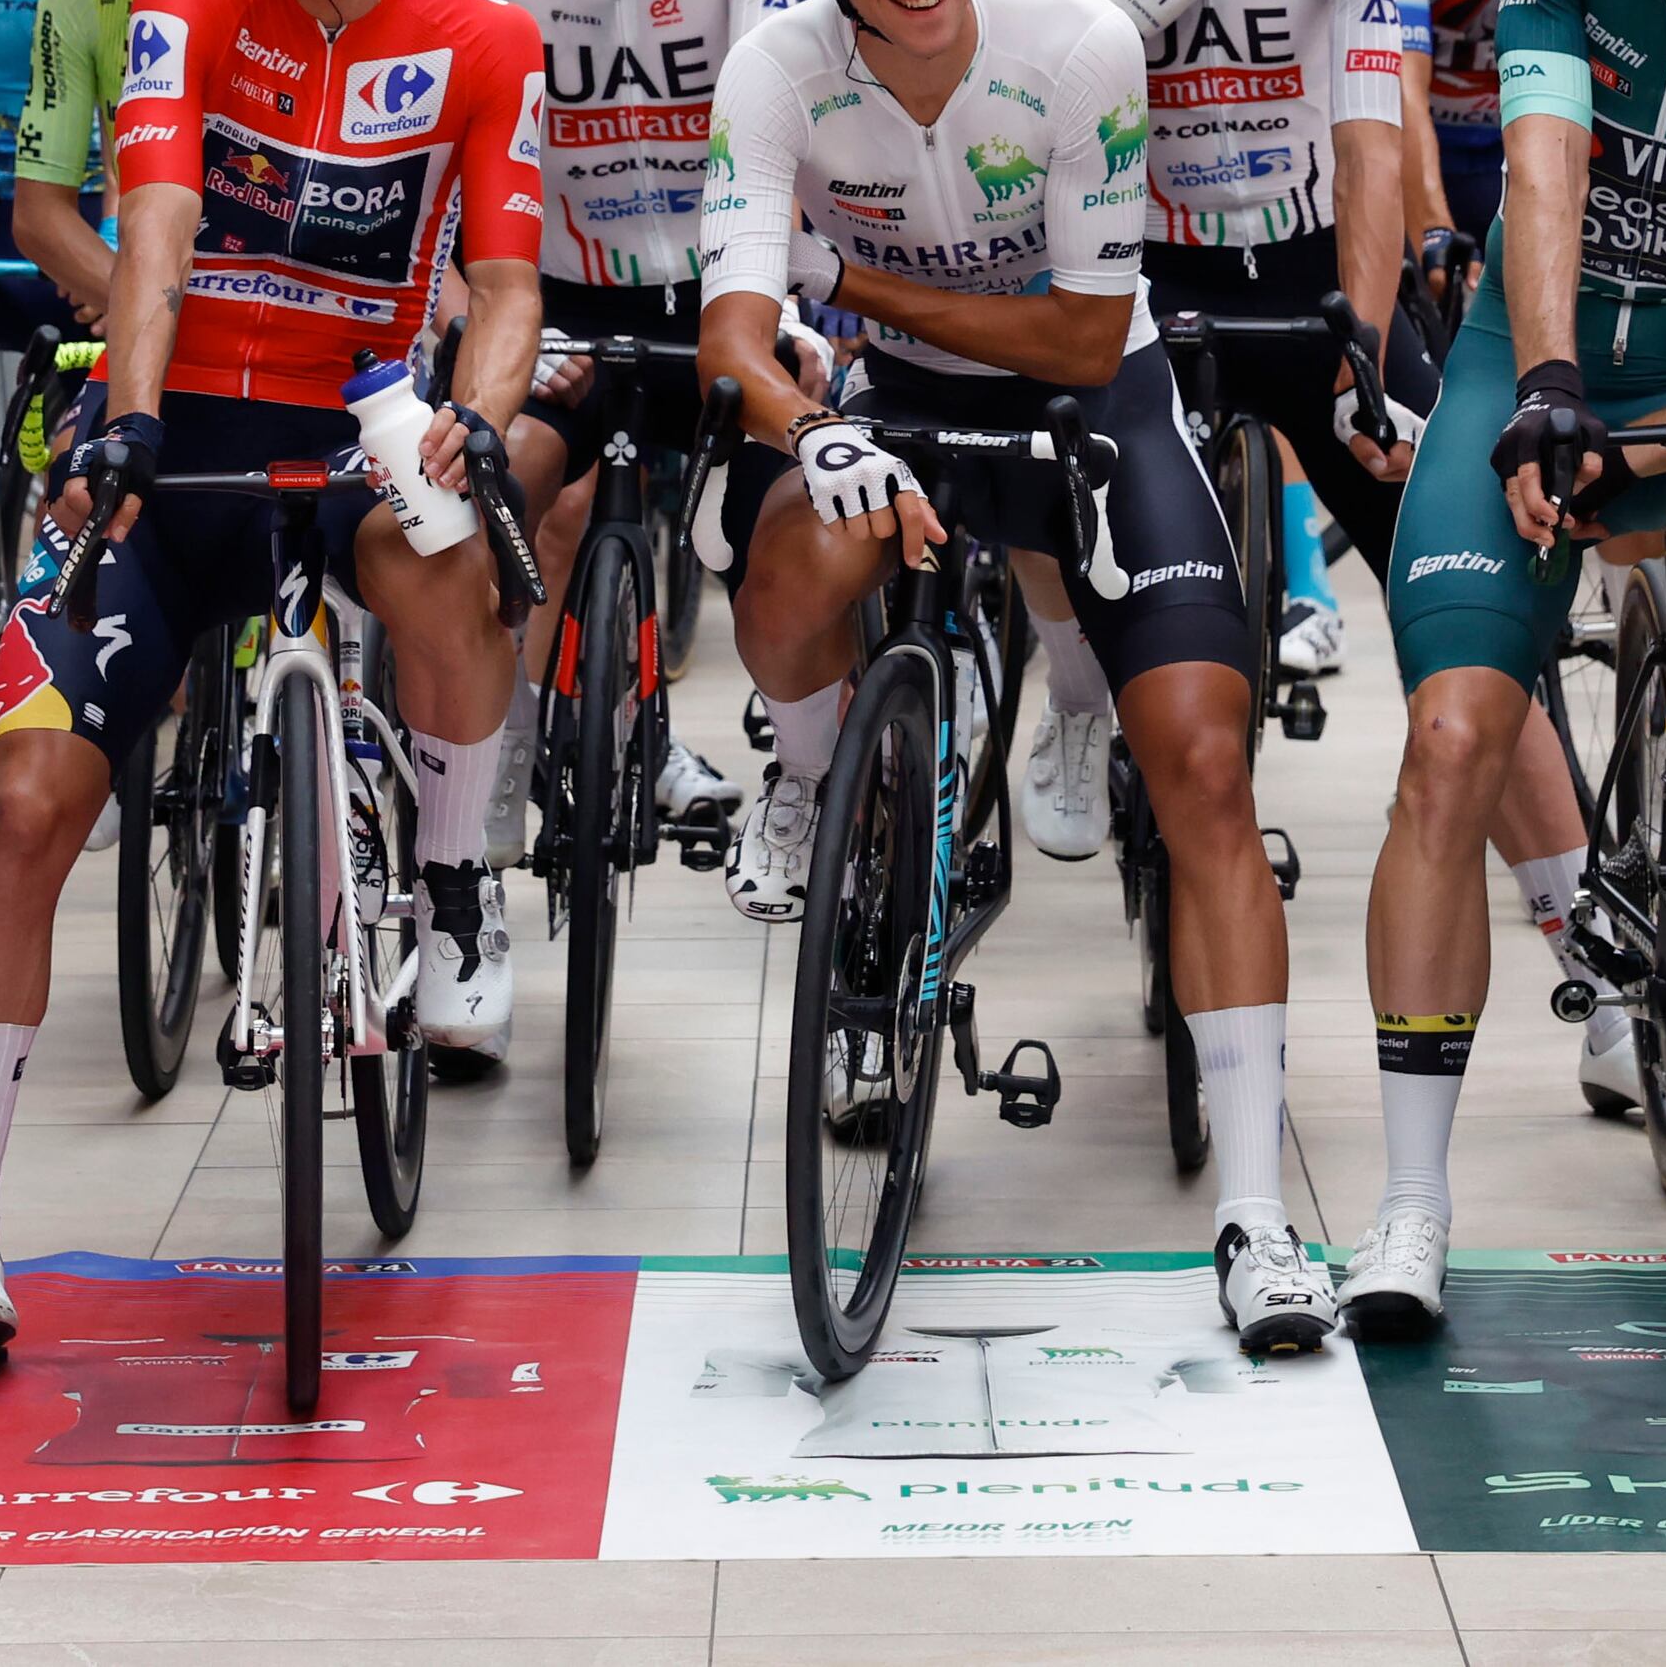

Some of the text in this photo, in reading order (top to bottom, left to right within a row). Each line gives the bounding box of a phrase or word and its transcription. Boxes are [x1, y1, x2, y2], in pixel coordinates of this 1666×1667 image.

[1583, 12, 1648, 69] Santini
[41, 10, 57, 112] TECHNORD
[235, 28, 308, 82] Santini
[544, 38, 715, 103] UAE
[988, 78, 1047, 117] plenitude
[1149, 75, 1300, 104] Emirates
[278, 96, 293, 113] 24
[810, 90, 862, 126] plenitude
[351, 114, 431, 137] Carrefour
[1177, 118, 1290, 138] COLNAGO
[828, 180, 906, 199] Santini
[1171, 168, 1246, 187] ADNOC
[303, 180, 406, 215] BORA
[303, 208, 402, 235] hansgrohe
[494, 506, 540, 580] SRAM
[54, 520, 95, 597] SRAM
[1406, 550, 1506, 583] Santini
[1133, 560, 1224, 593] Santini
[919, 1258, 1086, 1268] VUELTA 24
[1564, 1253, 1600, 1262] LA
[871, 1418, 1111, 1430] plenitude
[899, 1476, 1306, 1500] plenitude
[25, 1524, 309, 1542] CLASIFICACIÓN
[318, 1526, 488, 1540] GENERAL
[880, 1518, 1134, 1535] MEJOR JOVEN
[1540, 1513, 1644, 1529] LÍDER
